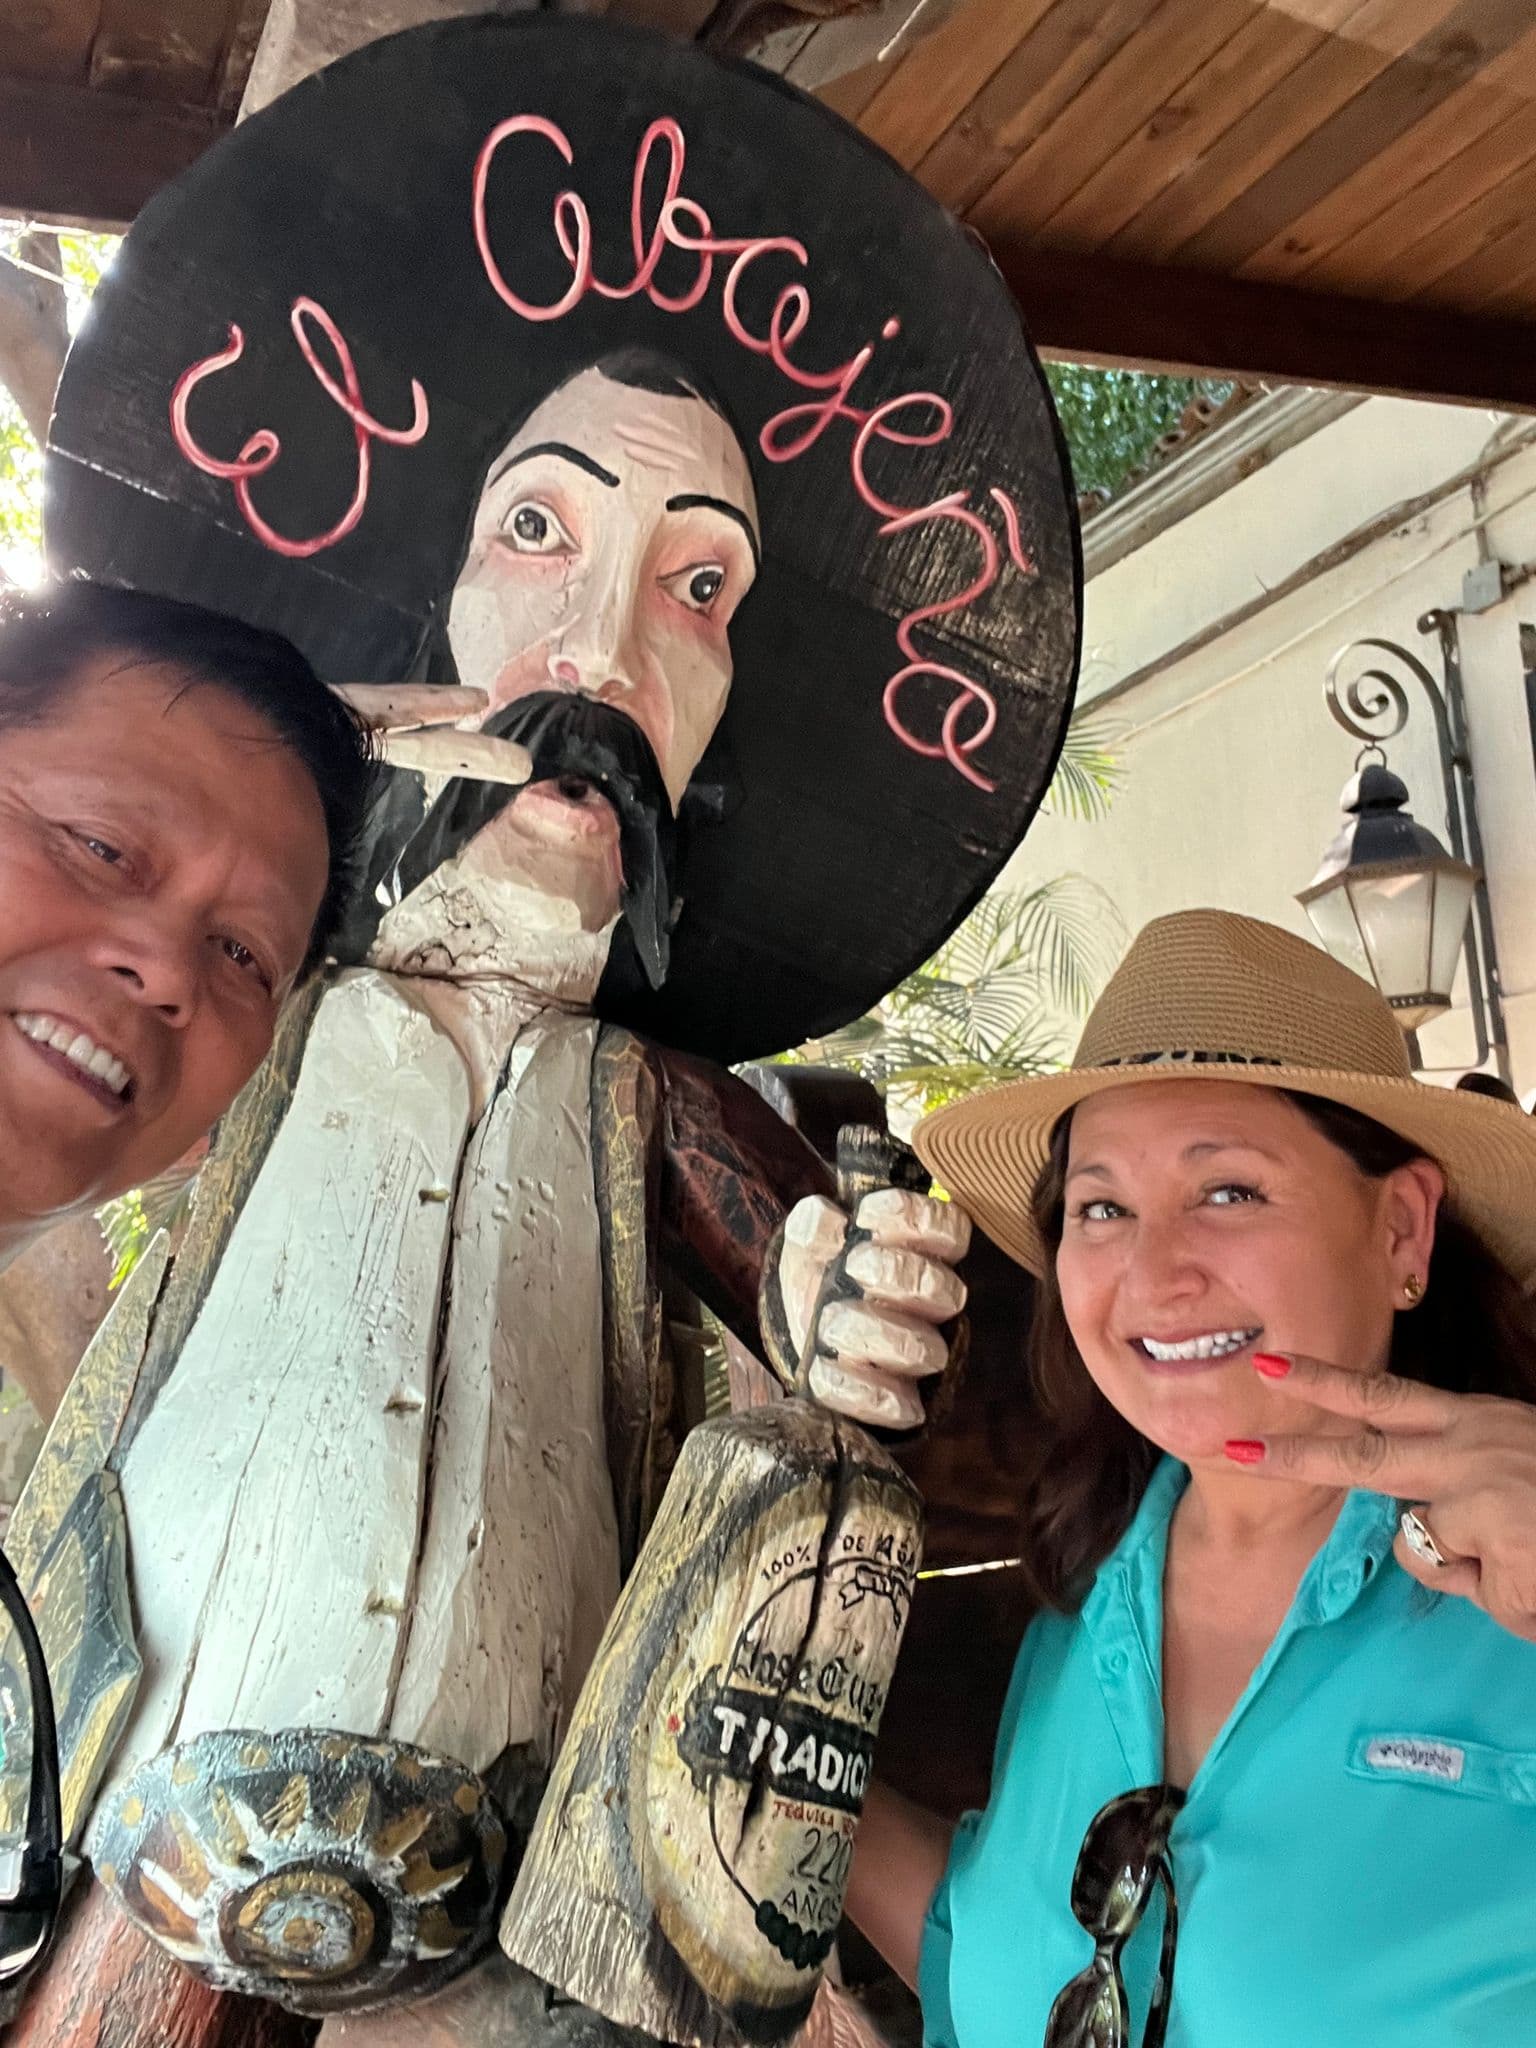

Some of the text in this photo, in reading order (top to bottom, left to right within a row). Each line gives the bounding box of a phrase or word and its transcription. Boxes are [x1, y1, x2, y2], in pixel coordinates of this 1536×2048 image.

[171, 295, 428, 557] El
[760, 1543, 811, 1581] 100%
[842, 1534, 866, 1552] DE
[797, 1827, 853, 1888] 220
